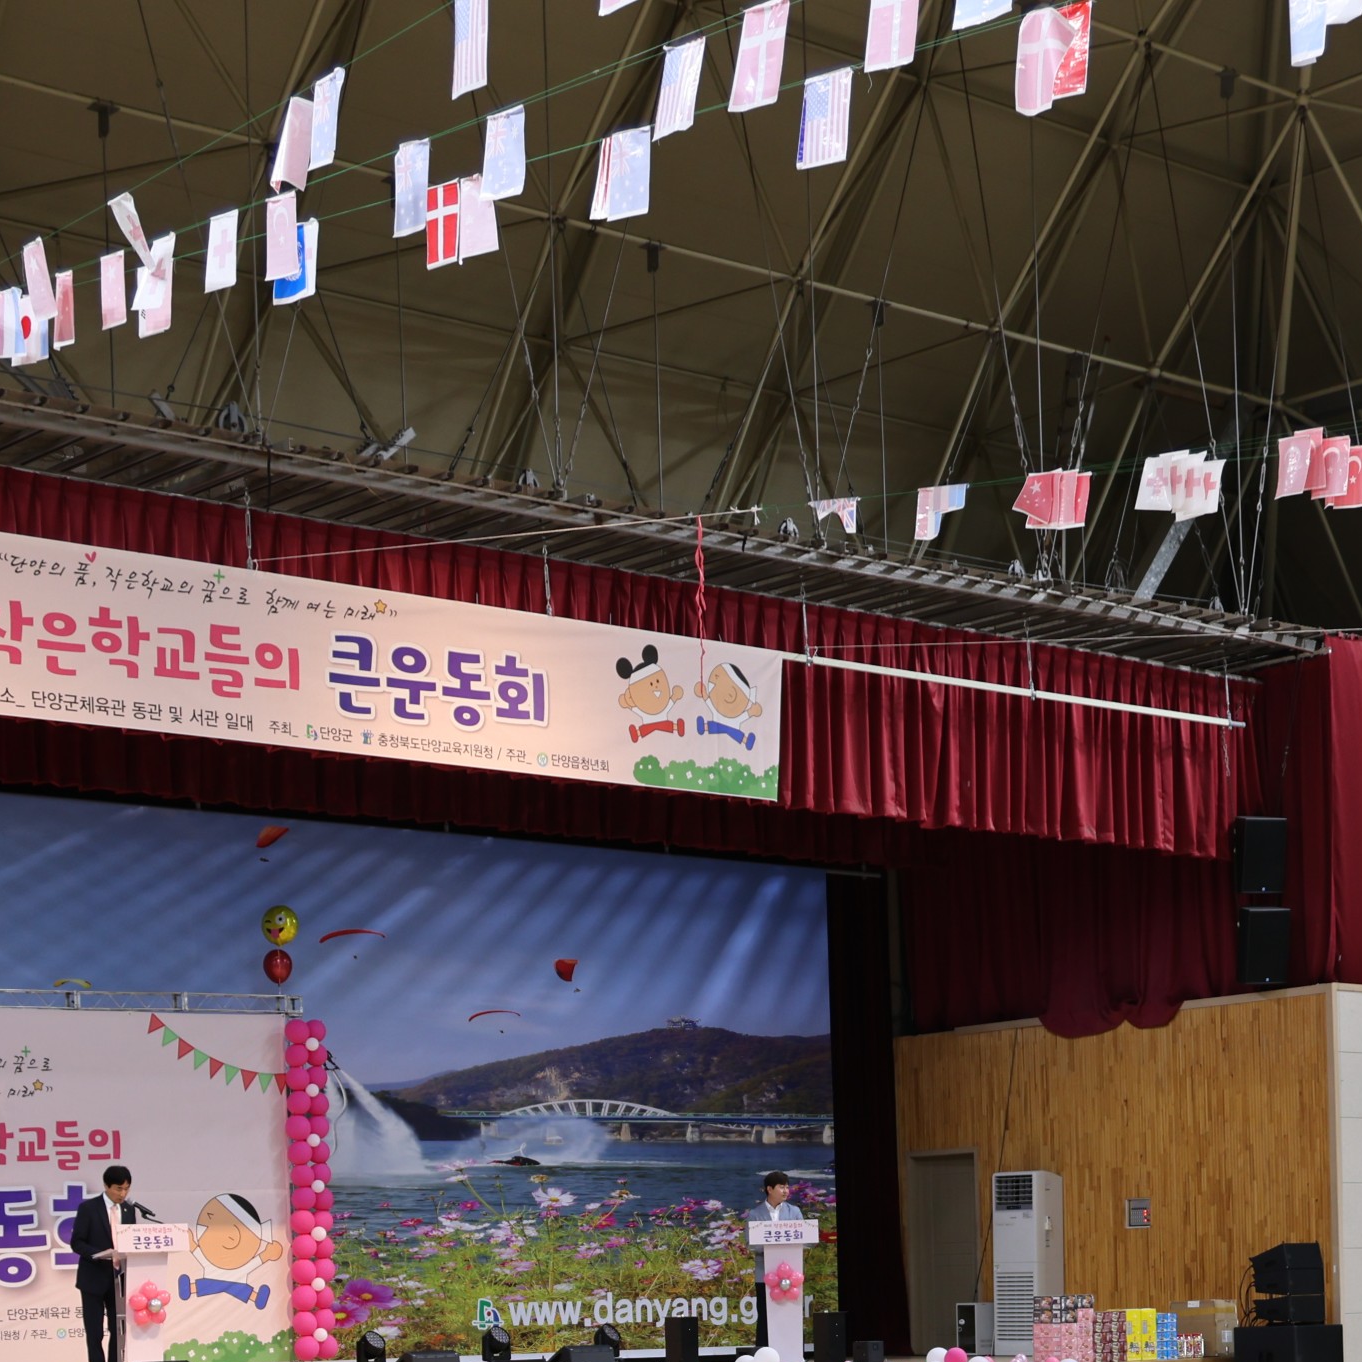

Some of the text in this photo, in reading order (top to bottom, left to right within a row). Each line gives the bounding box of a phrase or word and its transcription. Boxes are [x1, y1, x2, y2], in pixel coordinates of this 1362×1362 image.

[73, 560, 97, 588] 품,
[105, 566, 193, 601] 작은학교의
[201, 578, 251, 606] 꿈으로
[265, 587, 298, 615] 함께
[306, 599, 337, 619] 여는
[326, 631, 551, 730] 큰운동회
[31, 690, 127, 718] 단양군체육관
[131, 701, 163, 722] 동관
[168, 705, 183, 724] 및
[189, 708, 220, 729] 서관
[225, 712, 254, 732] 일대
[320, 725, 354, 744] 단양군
[377, 733, 494, 761] 충청북도단양교육지원청
[550, 753, 610, 773] 단양읍청년회
[13, 1054, 52, 1073] 꿈으로
[133, 1236, 174, 1249] 큰운동회
[764, 1230, 803, 1242] 큰운동회
[7, 1306, 71, 1321] 단양군체육관
